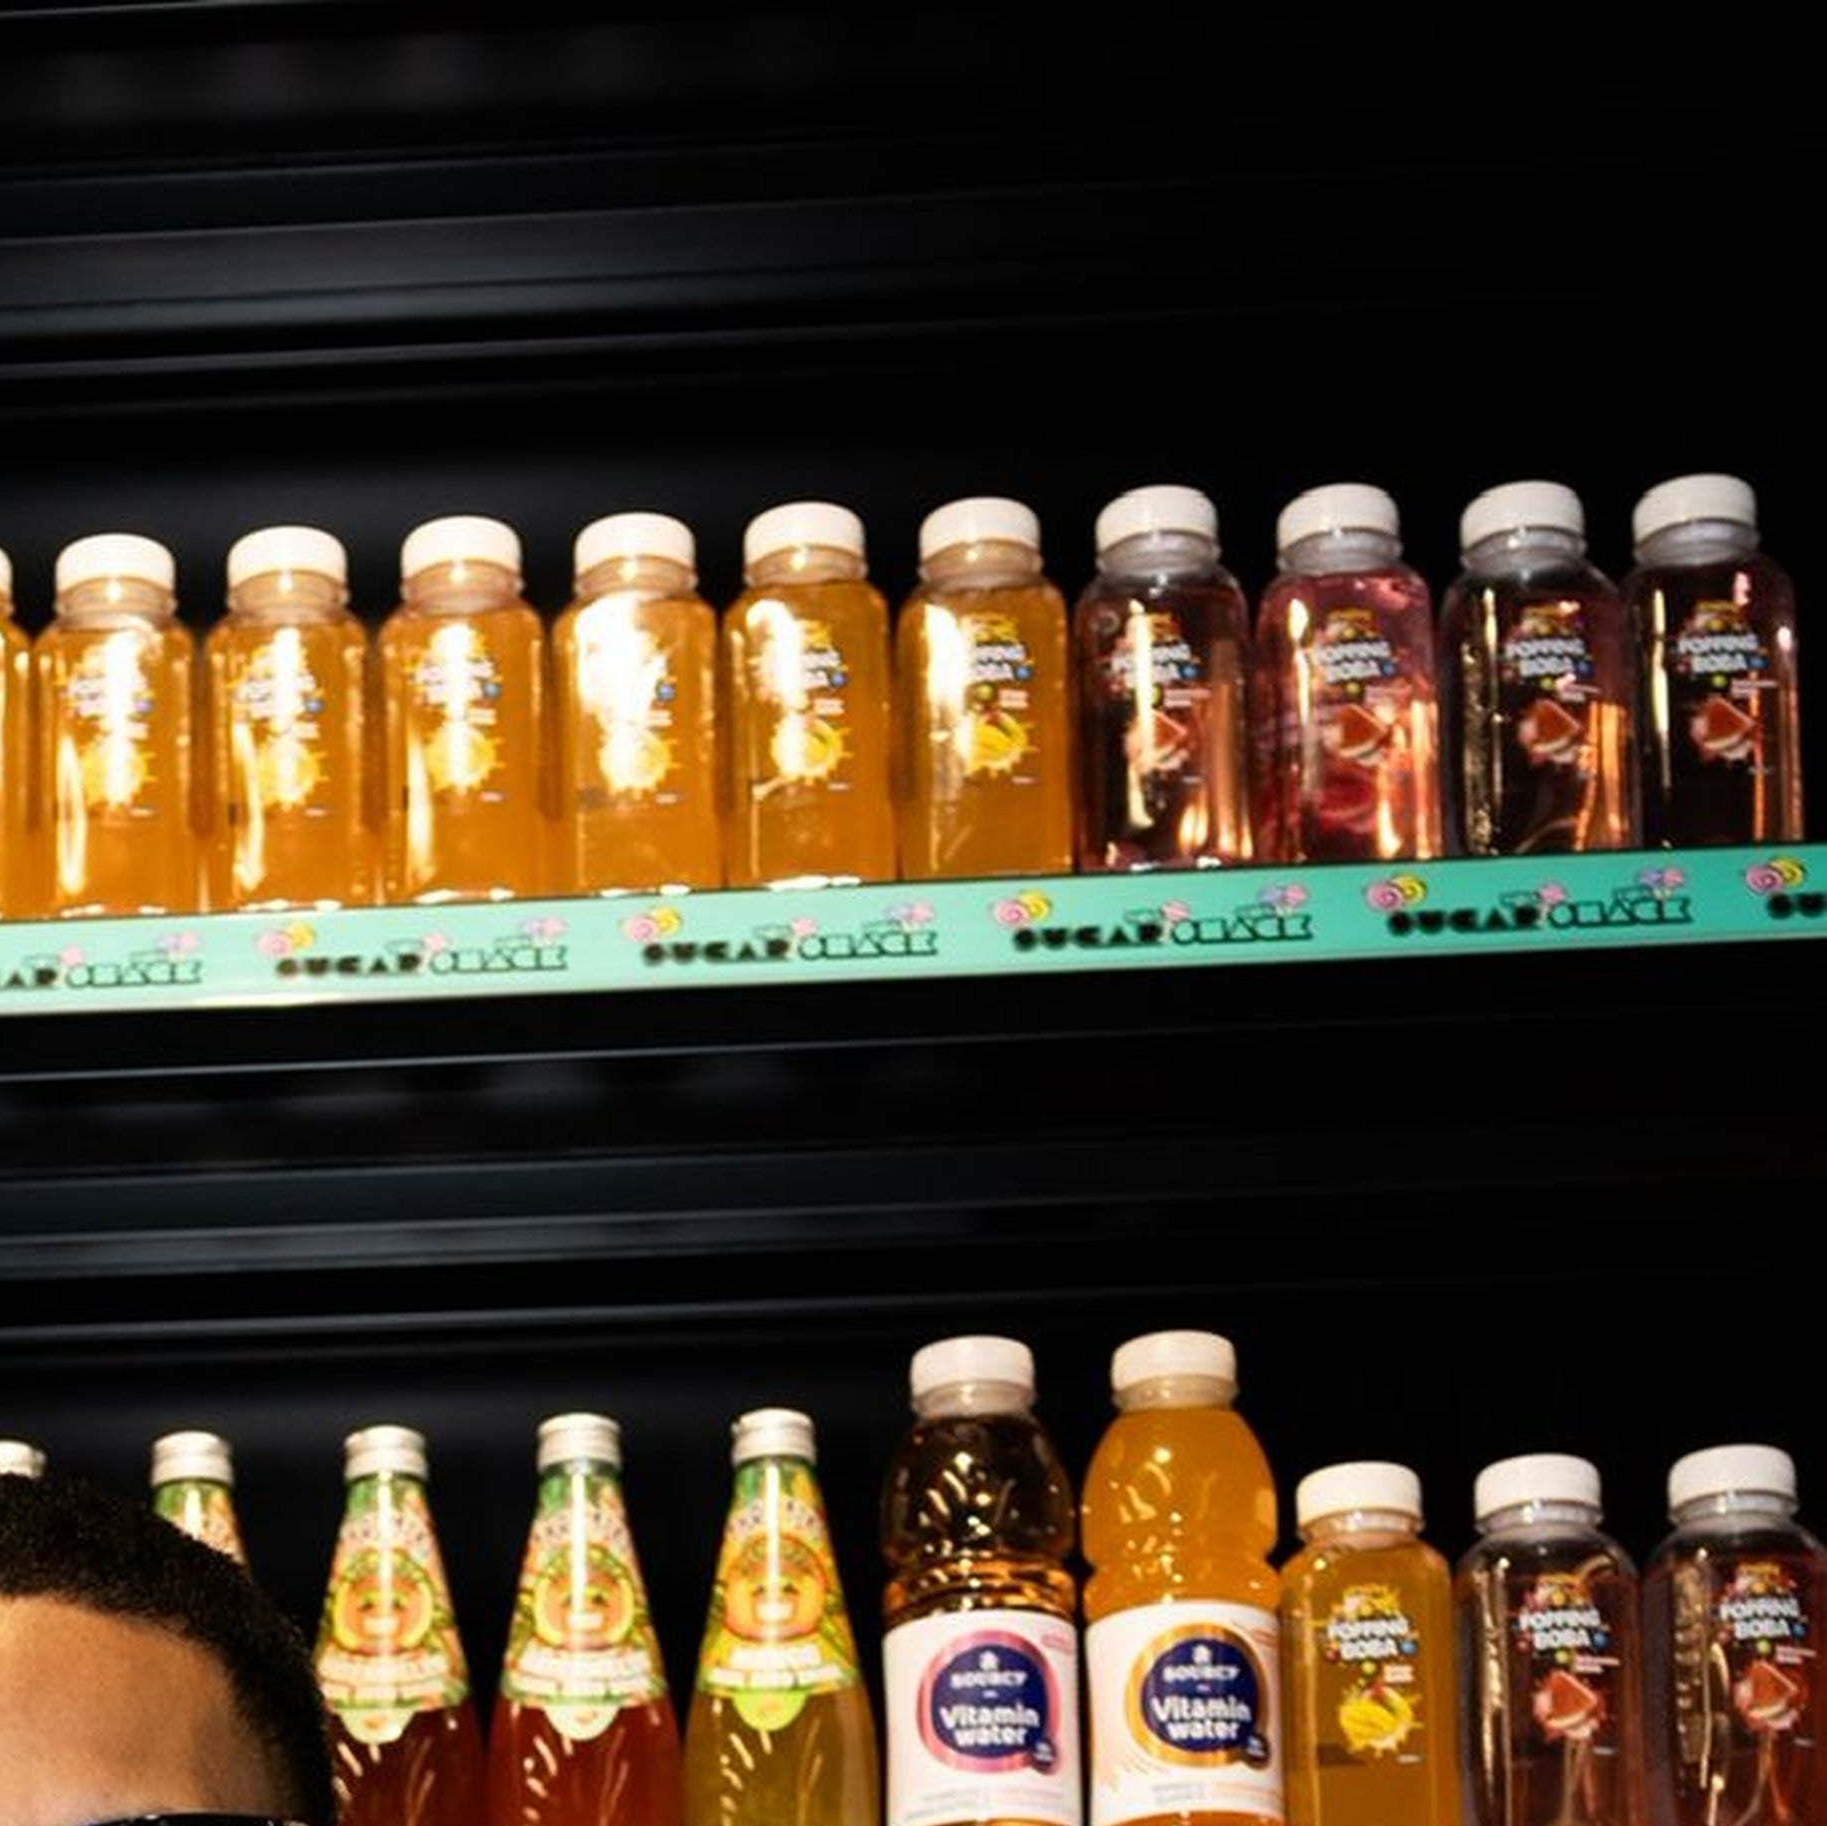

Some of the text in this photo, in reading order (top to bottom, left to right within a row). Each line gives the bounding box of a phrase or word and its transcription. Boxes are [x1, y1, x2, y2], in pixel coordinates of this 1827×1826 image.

[1388, 906, 1539, 937] SUGAR
[1011, 926, 1163, 955] SUGAR
[641, 942, 791, 968] SUGAR
[940, 1703, 1040, 1730] Vitamin
[1152, 1695, 1251, 1724] Vitamin
[954, 1726, 1028, 1748] water
[1165, 1719, 1240, 1742] water
